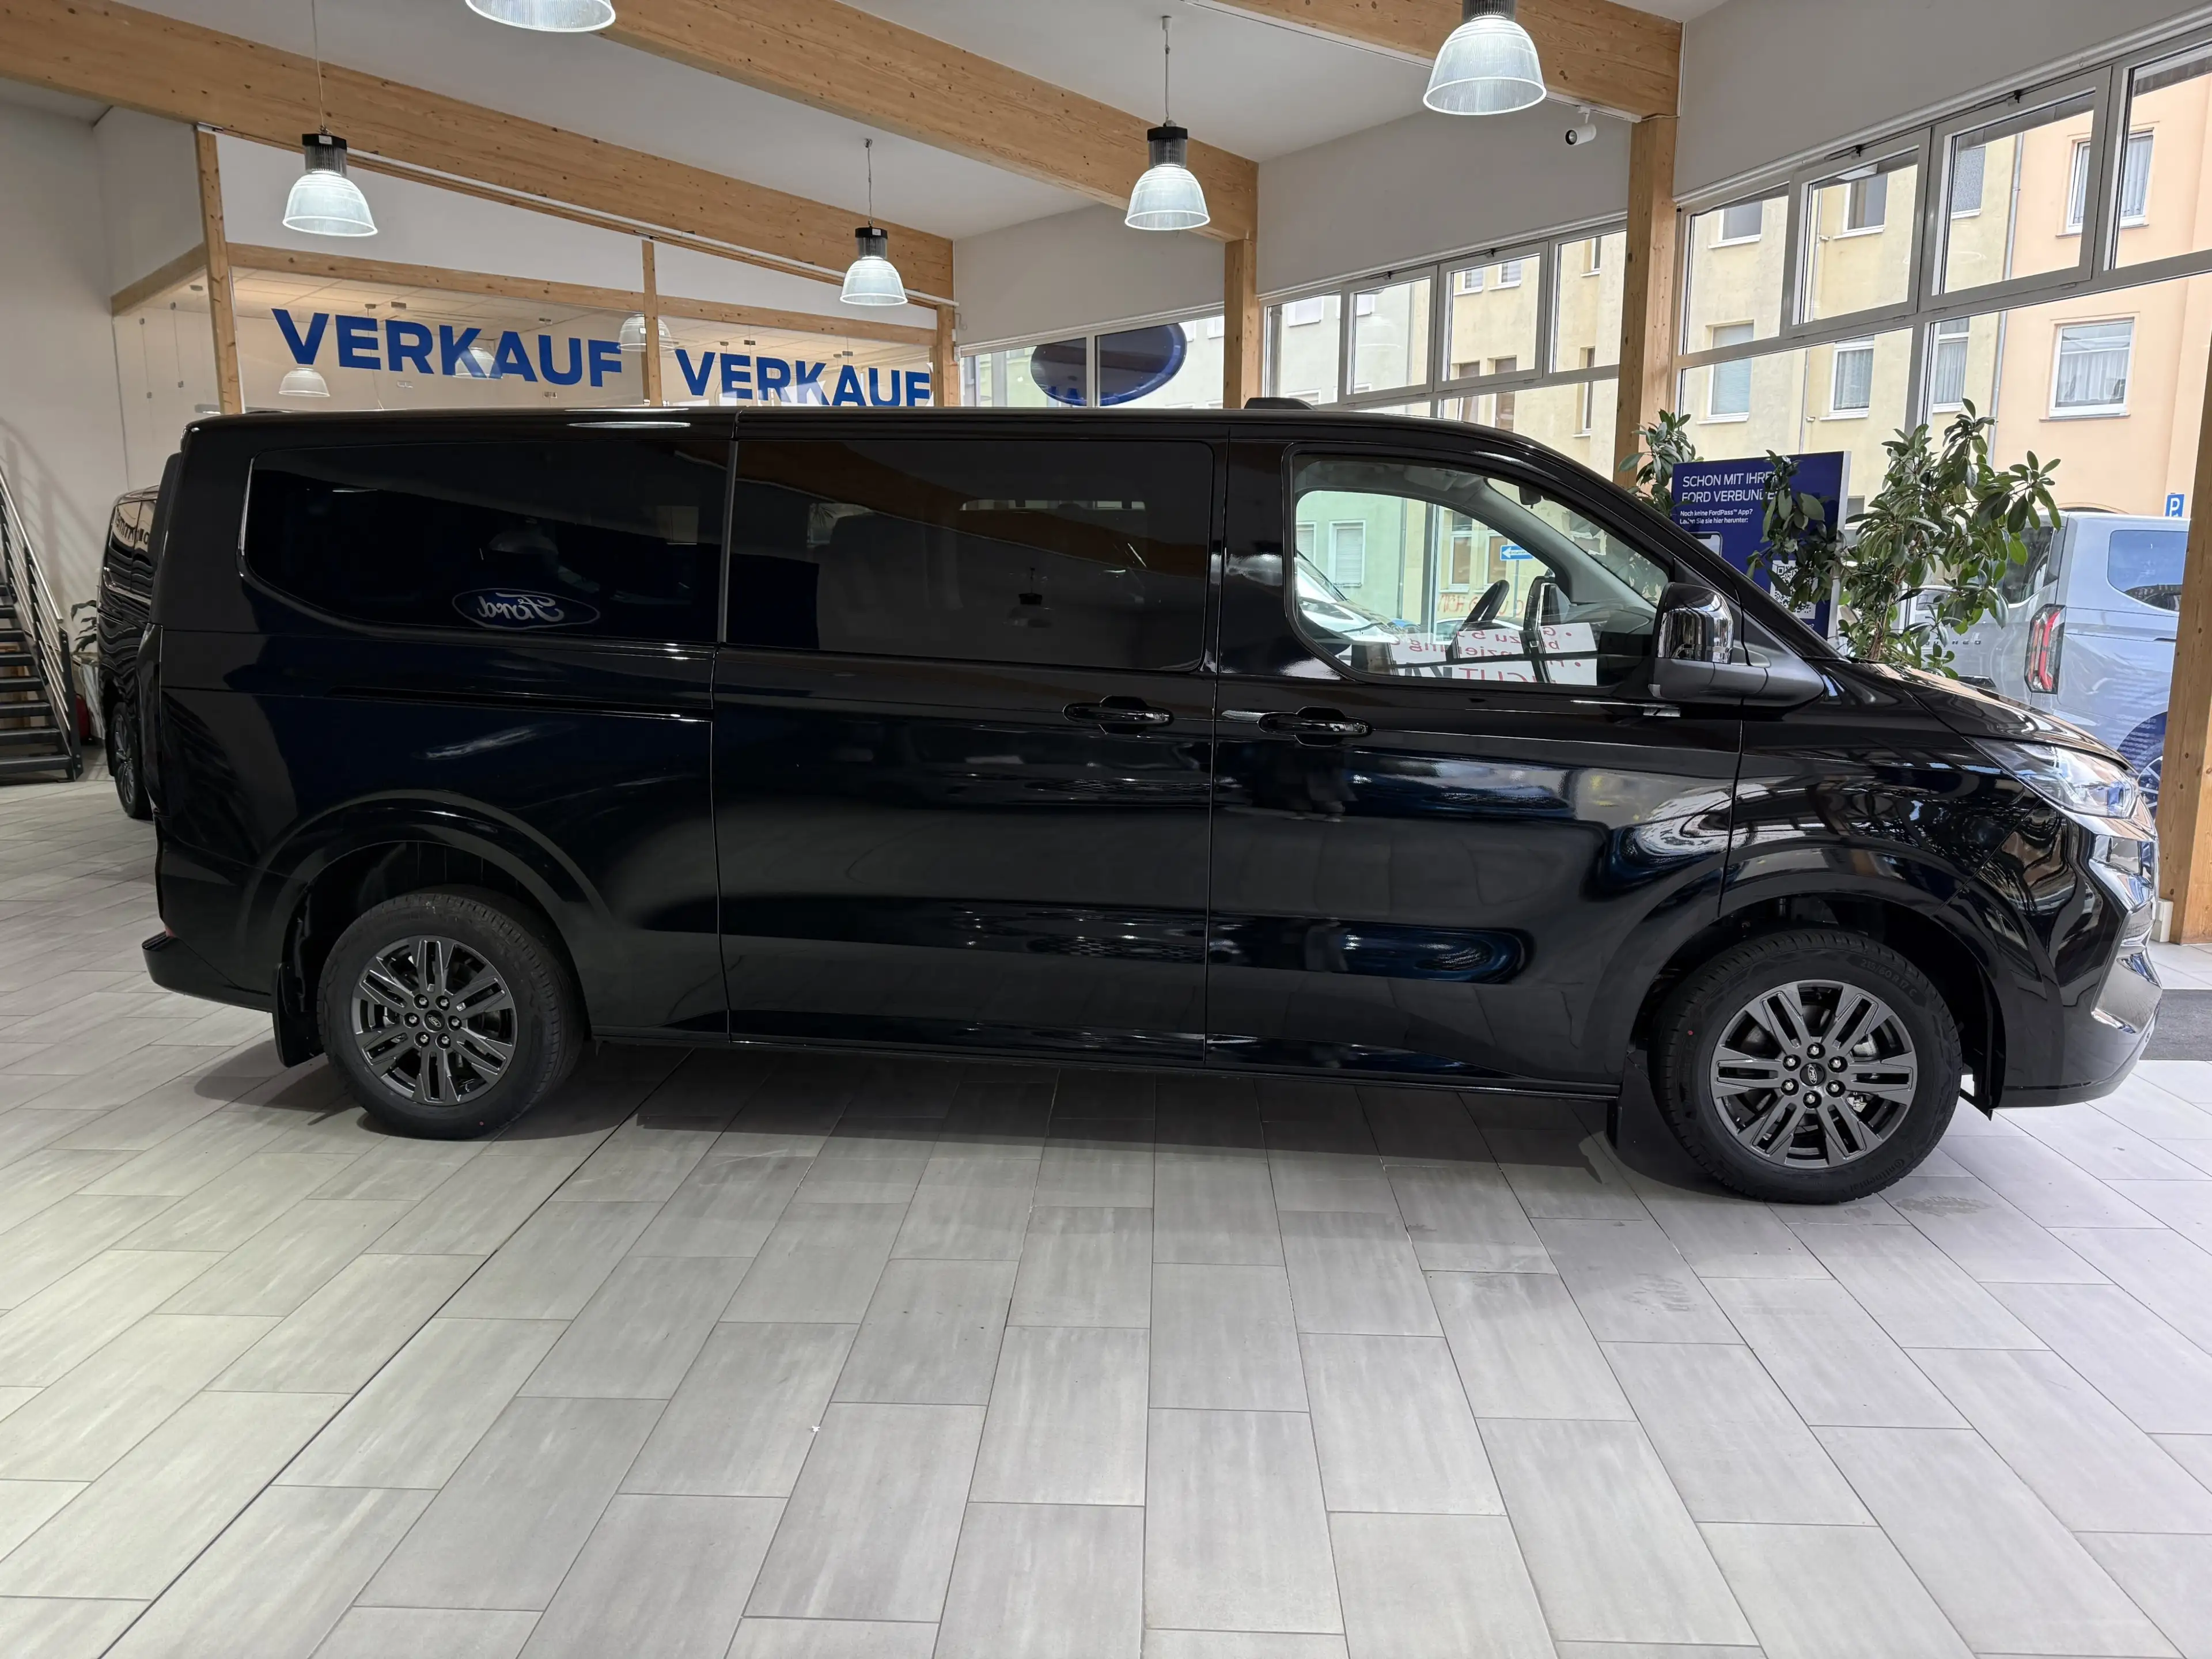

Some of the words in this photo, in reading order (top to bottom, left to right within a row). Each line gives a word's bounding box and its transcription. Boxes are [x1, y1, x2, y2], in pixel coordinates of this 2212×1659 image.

[271, 308, 622, 387] VERKAUF
[674, 348, 930, 407] VERKAUF
[1683, 474, 1721, 487] SCHON
[1724, 473, 1744, 486] MIT
[1681, 491, 1711, 503] FORD
[1737, 508, 1753, 516] App?
[2169, 497, 2180, 517] P
